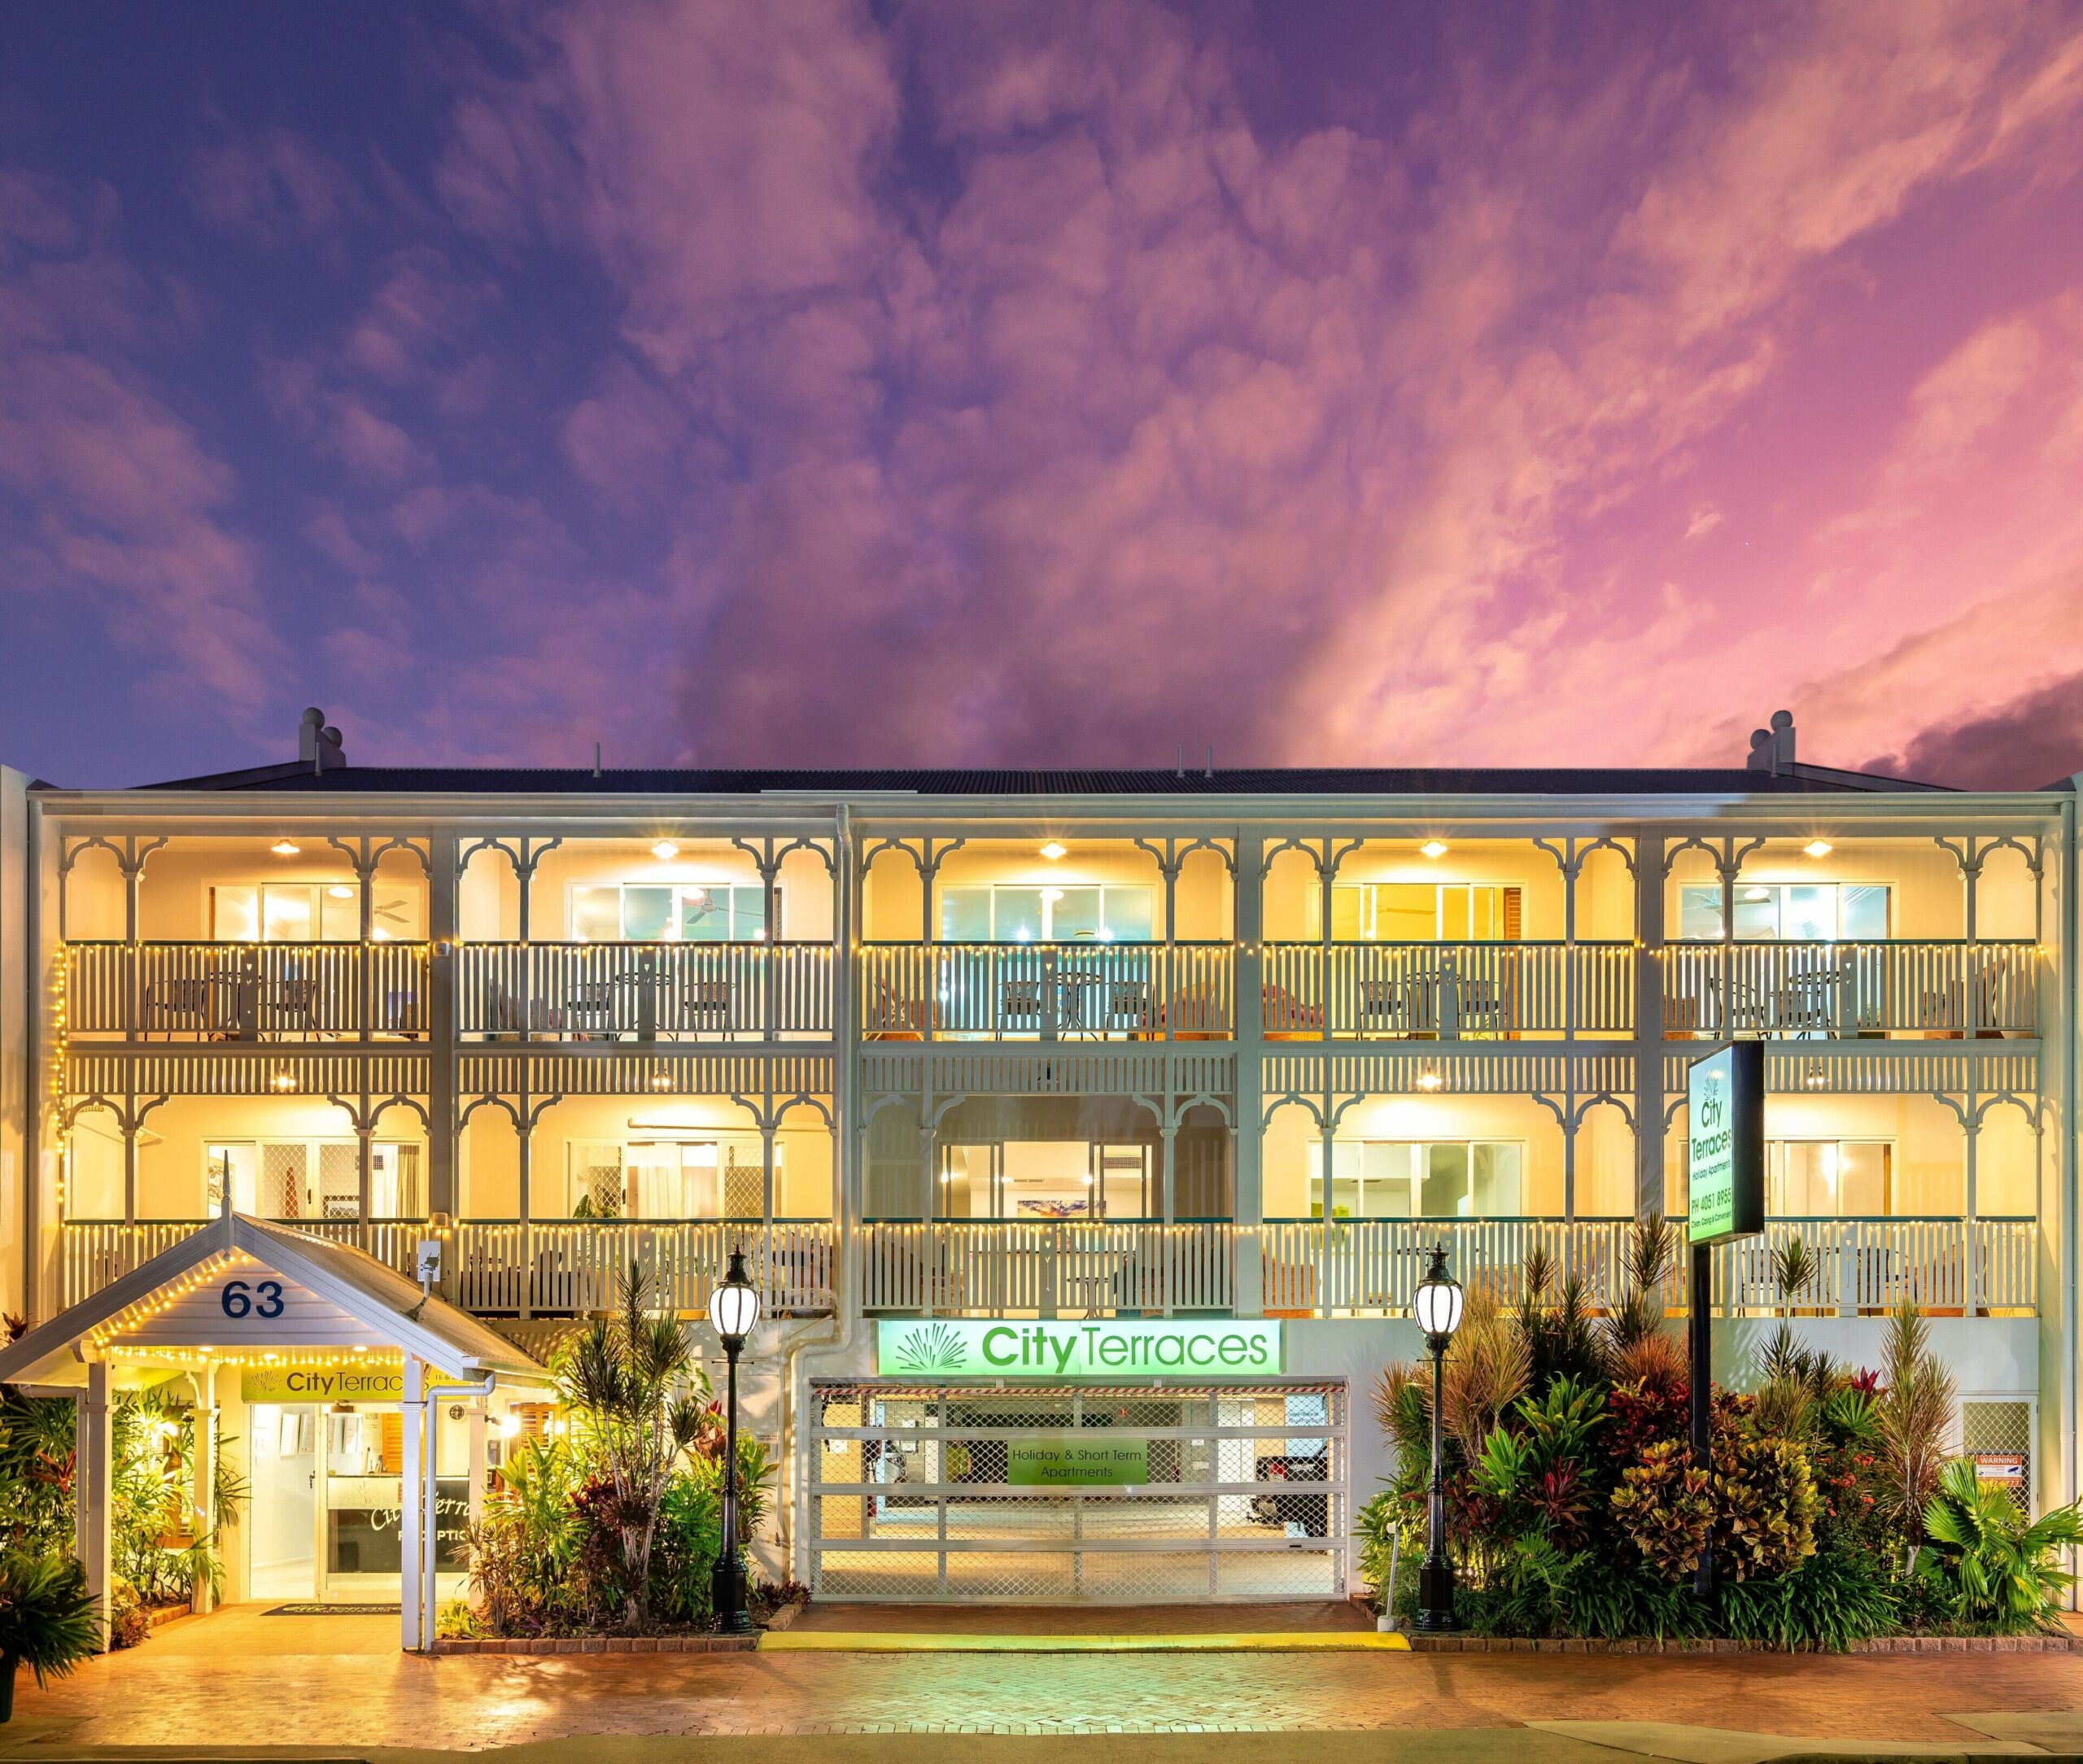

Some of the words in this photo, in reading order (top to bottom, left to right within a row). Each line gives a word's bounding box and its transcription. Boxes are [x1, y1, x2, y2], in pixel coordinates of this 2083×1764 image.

[1701, 1098, 1722, 1128] City
[1692, 1129, 1731, 1162] Terraces
[1692, 1168, 1708, 1181] Holiday
[1709, 1159, 1731, 1177] Apartments
[1692, 1198, 1699, 1214] PH
[1701, 1193, 1714, 1211] 4051
[1717, 1188, 1731, 1206] 8955
[221, 1281, 285, 1318] 63
[982, 1327, 1077, 1373] City
[1081, 1327, 1268, 1365] Terraces
[286, 1372, 334, 1395] City
[1012, 1449, 1060, 1463] Holiday
[1064, 1450, 1074, 1461] &
[1077, 1449, 1108, 1461] Short
[1112, 1449, 1142, 1461] Term
[1041, 1466, 1113, 1479] Apartments
